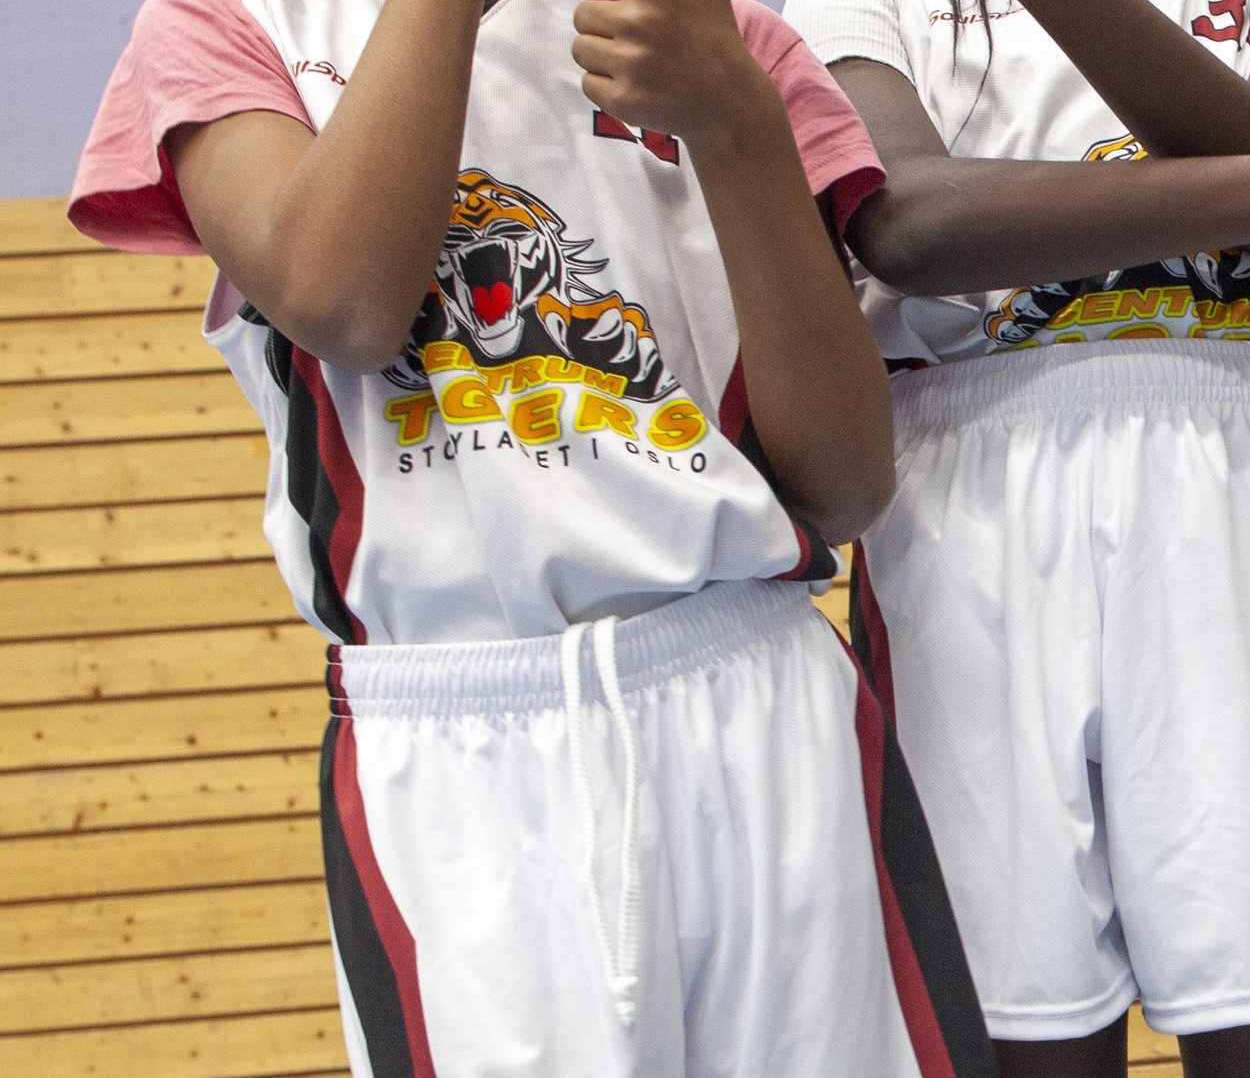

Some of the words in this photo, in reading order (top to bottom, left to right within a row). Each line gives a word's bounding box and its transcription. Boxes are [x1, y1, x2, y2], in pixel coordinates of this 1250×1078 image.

[385, 375, 709, 452] TGERS
[591, 438, 599, 460] I
[626, 441, 707, 474] OSLO
